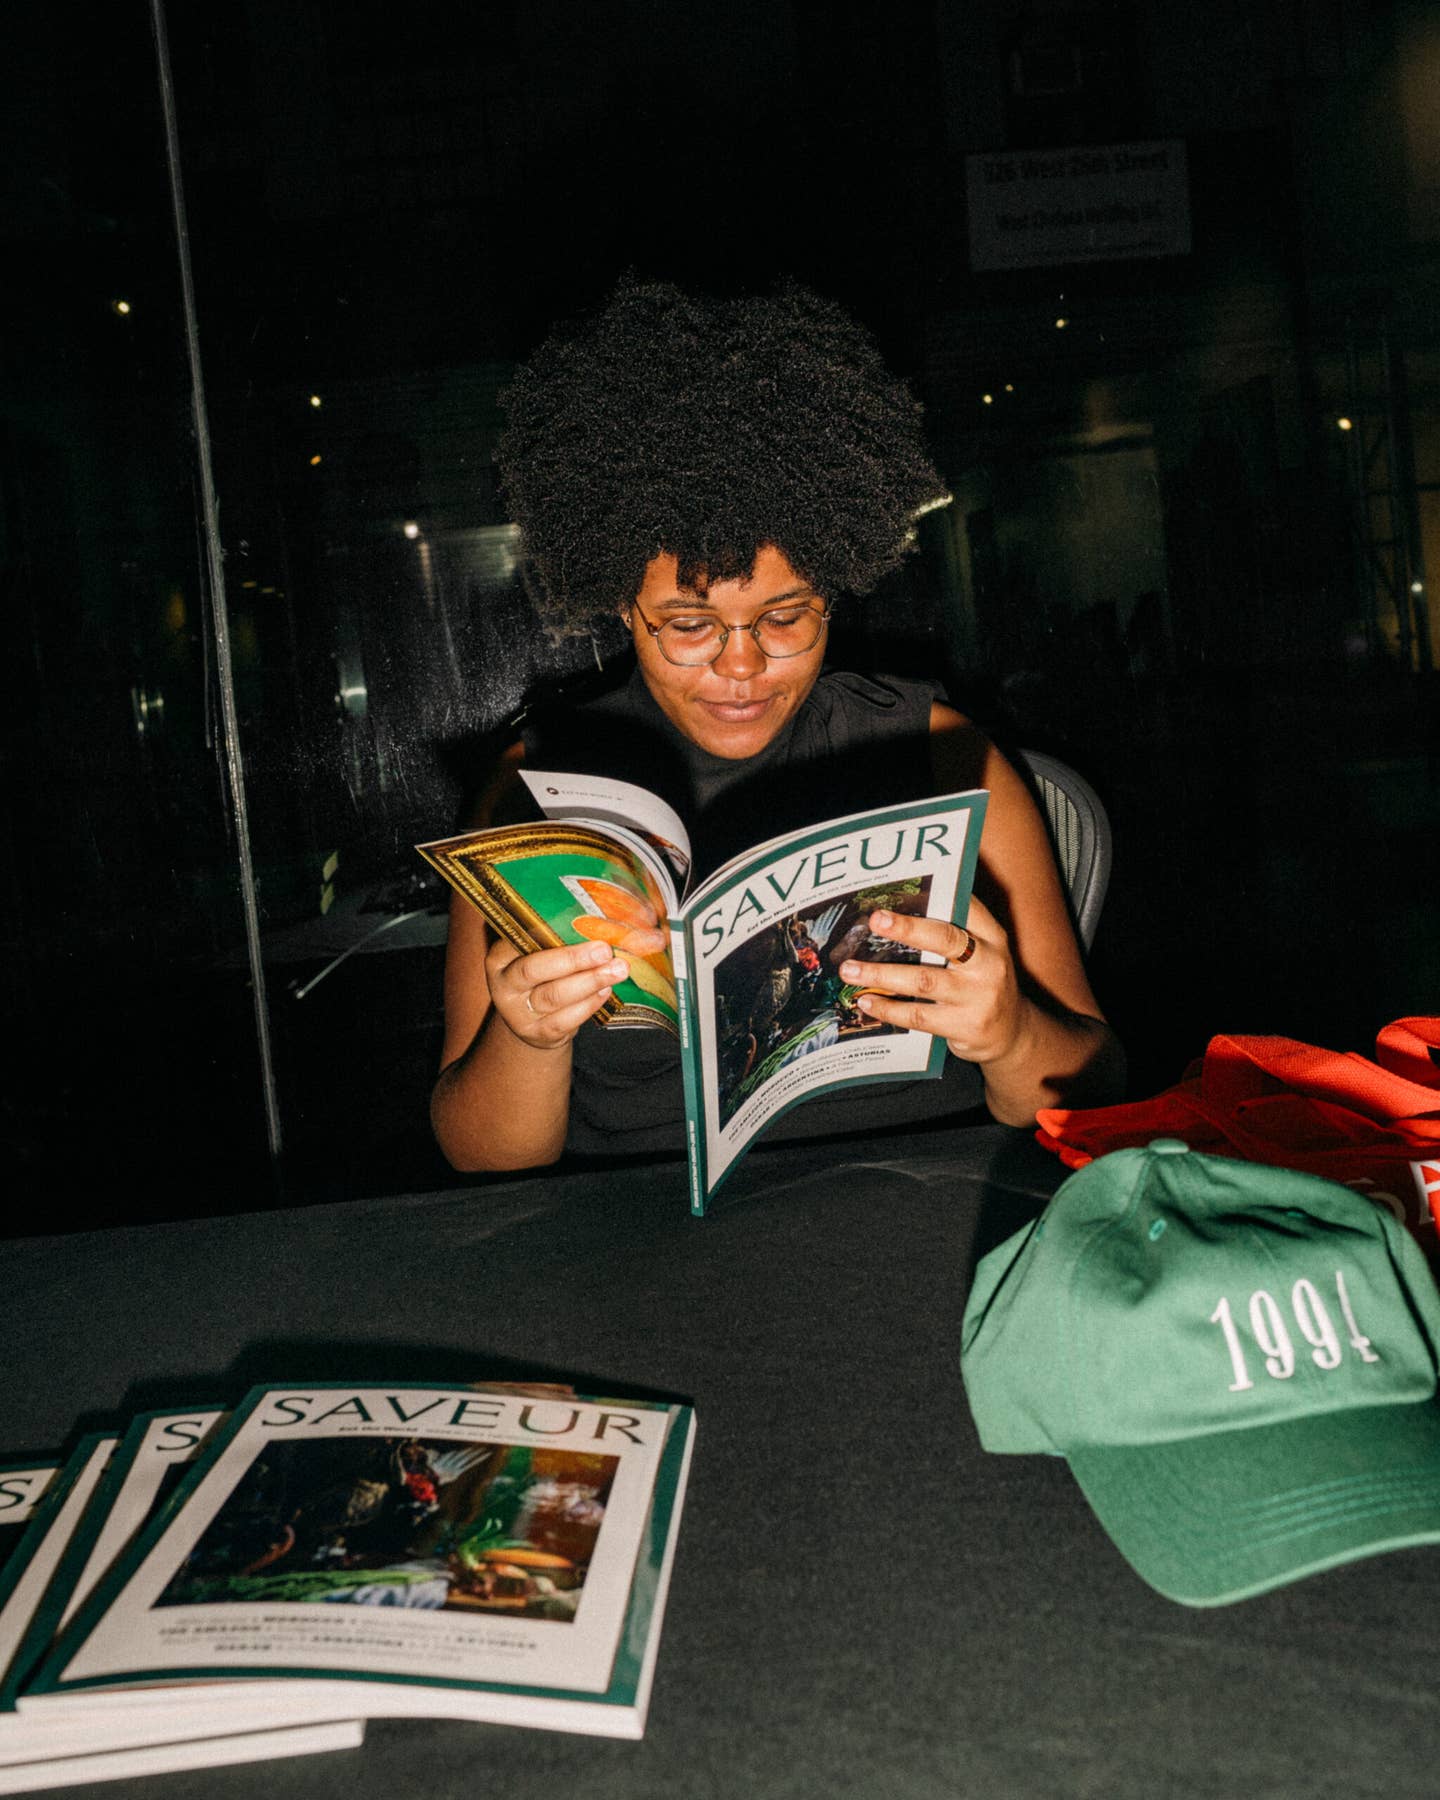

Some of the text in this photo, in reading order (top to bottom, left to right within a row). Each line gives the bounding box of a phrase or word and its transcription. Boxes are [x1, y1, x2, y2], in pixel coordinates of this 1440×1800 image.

[702, 823, 952, 959] SAVEUR
[848, 1048, 891, 1060] ASTURIAS
[261, 1394, 645, 1445] SAVEUR
